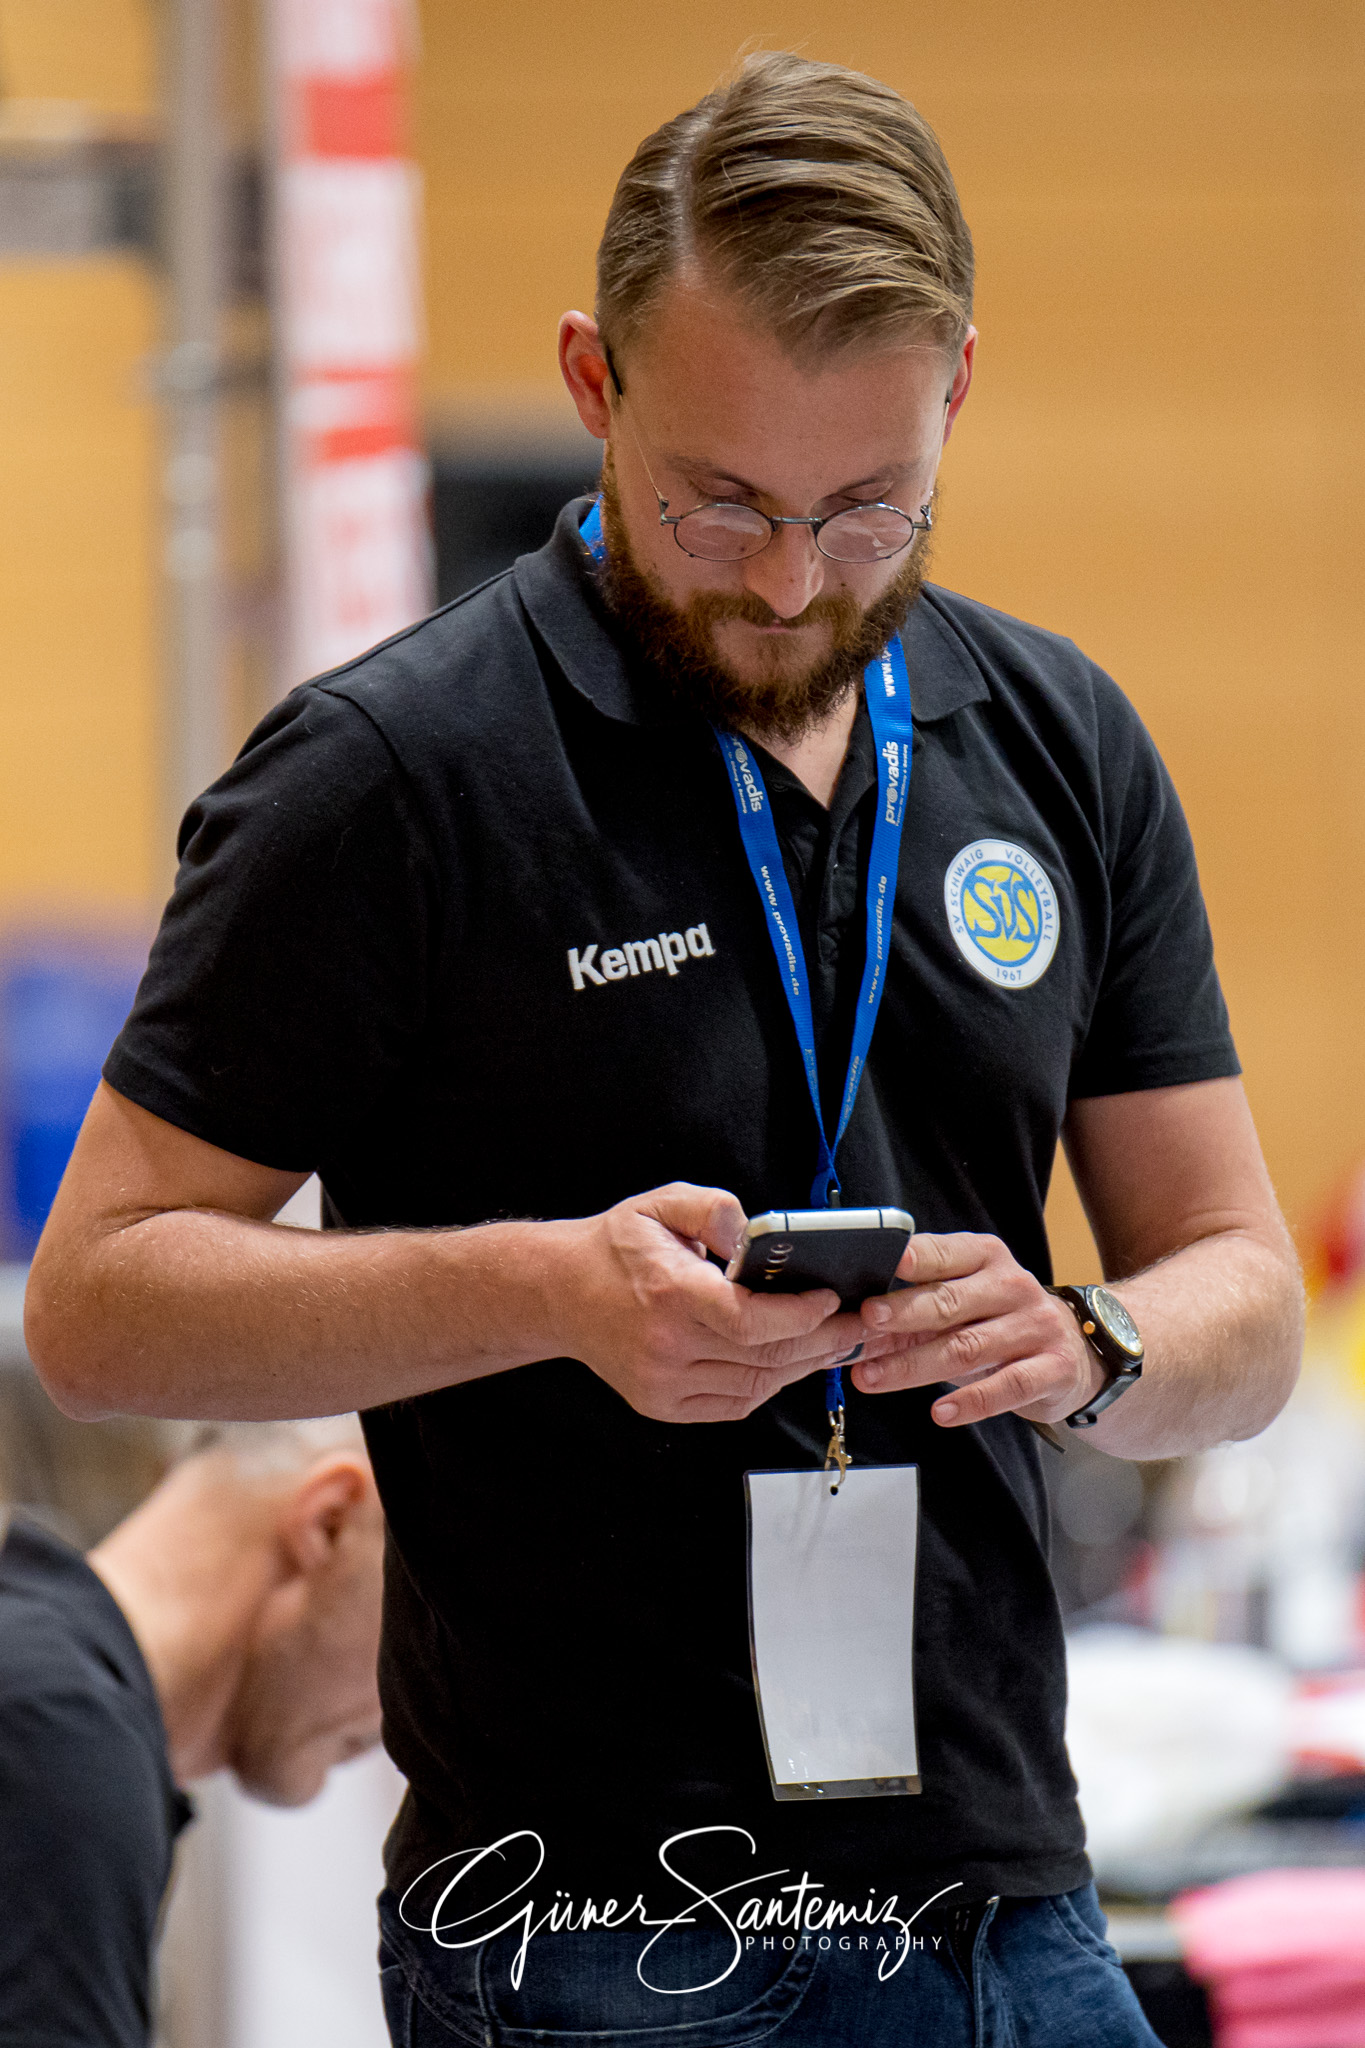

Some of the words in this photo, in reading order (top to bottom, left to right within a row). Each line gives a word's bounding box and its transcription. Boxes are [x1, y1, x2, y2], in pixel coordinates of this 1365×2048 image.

[882, 741, 899, 825] provadis
[950, 848, 984, 907] SCHWAIG
[1005, 848, 1053, 941] VOLLEYBALL
[567, 922, 716, 991] Kempa
[760, 865, 799, 996] www.provadis.de
[868, 875, 887, 1004] wwwprovadis.de
[952, 914, 965, 934] SV
[996, 967, 1022, 982] 1967
